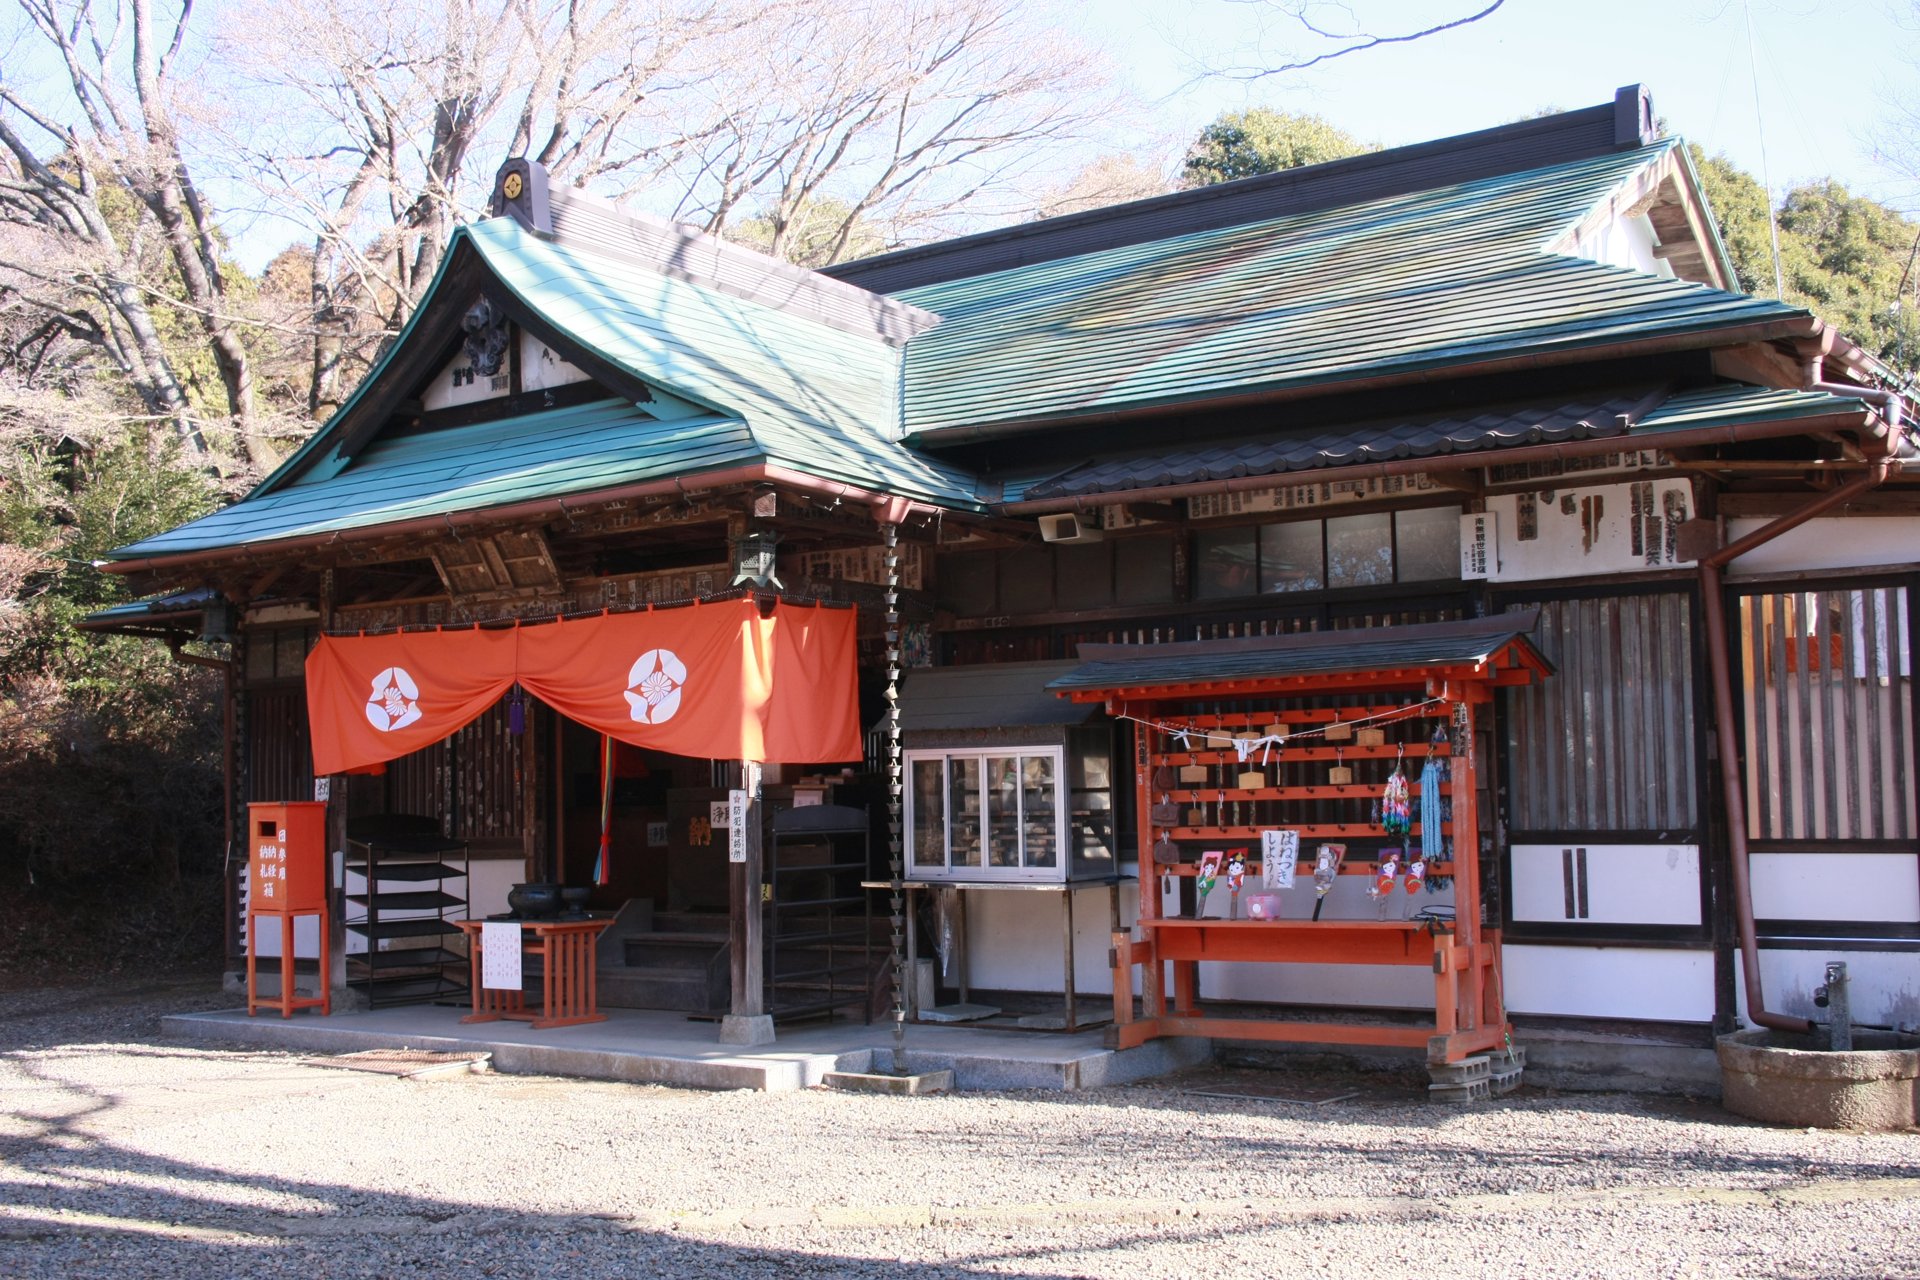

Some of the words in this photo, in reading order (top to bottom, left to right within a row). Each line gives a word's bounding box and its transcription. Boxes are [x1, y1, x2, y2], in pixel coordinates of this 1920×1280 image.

[1475, 517, 1486, 573] 南無観世音菩薩
[734, 806, 742, 859] 防犯連絡所
[1277, 832, 1294, 884] はねつき
[264, 882, 274, 897] 箱
